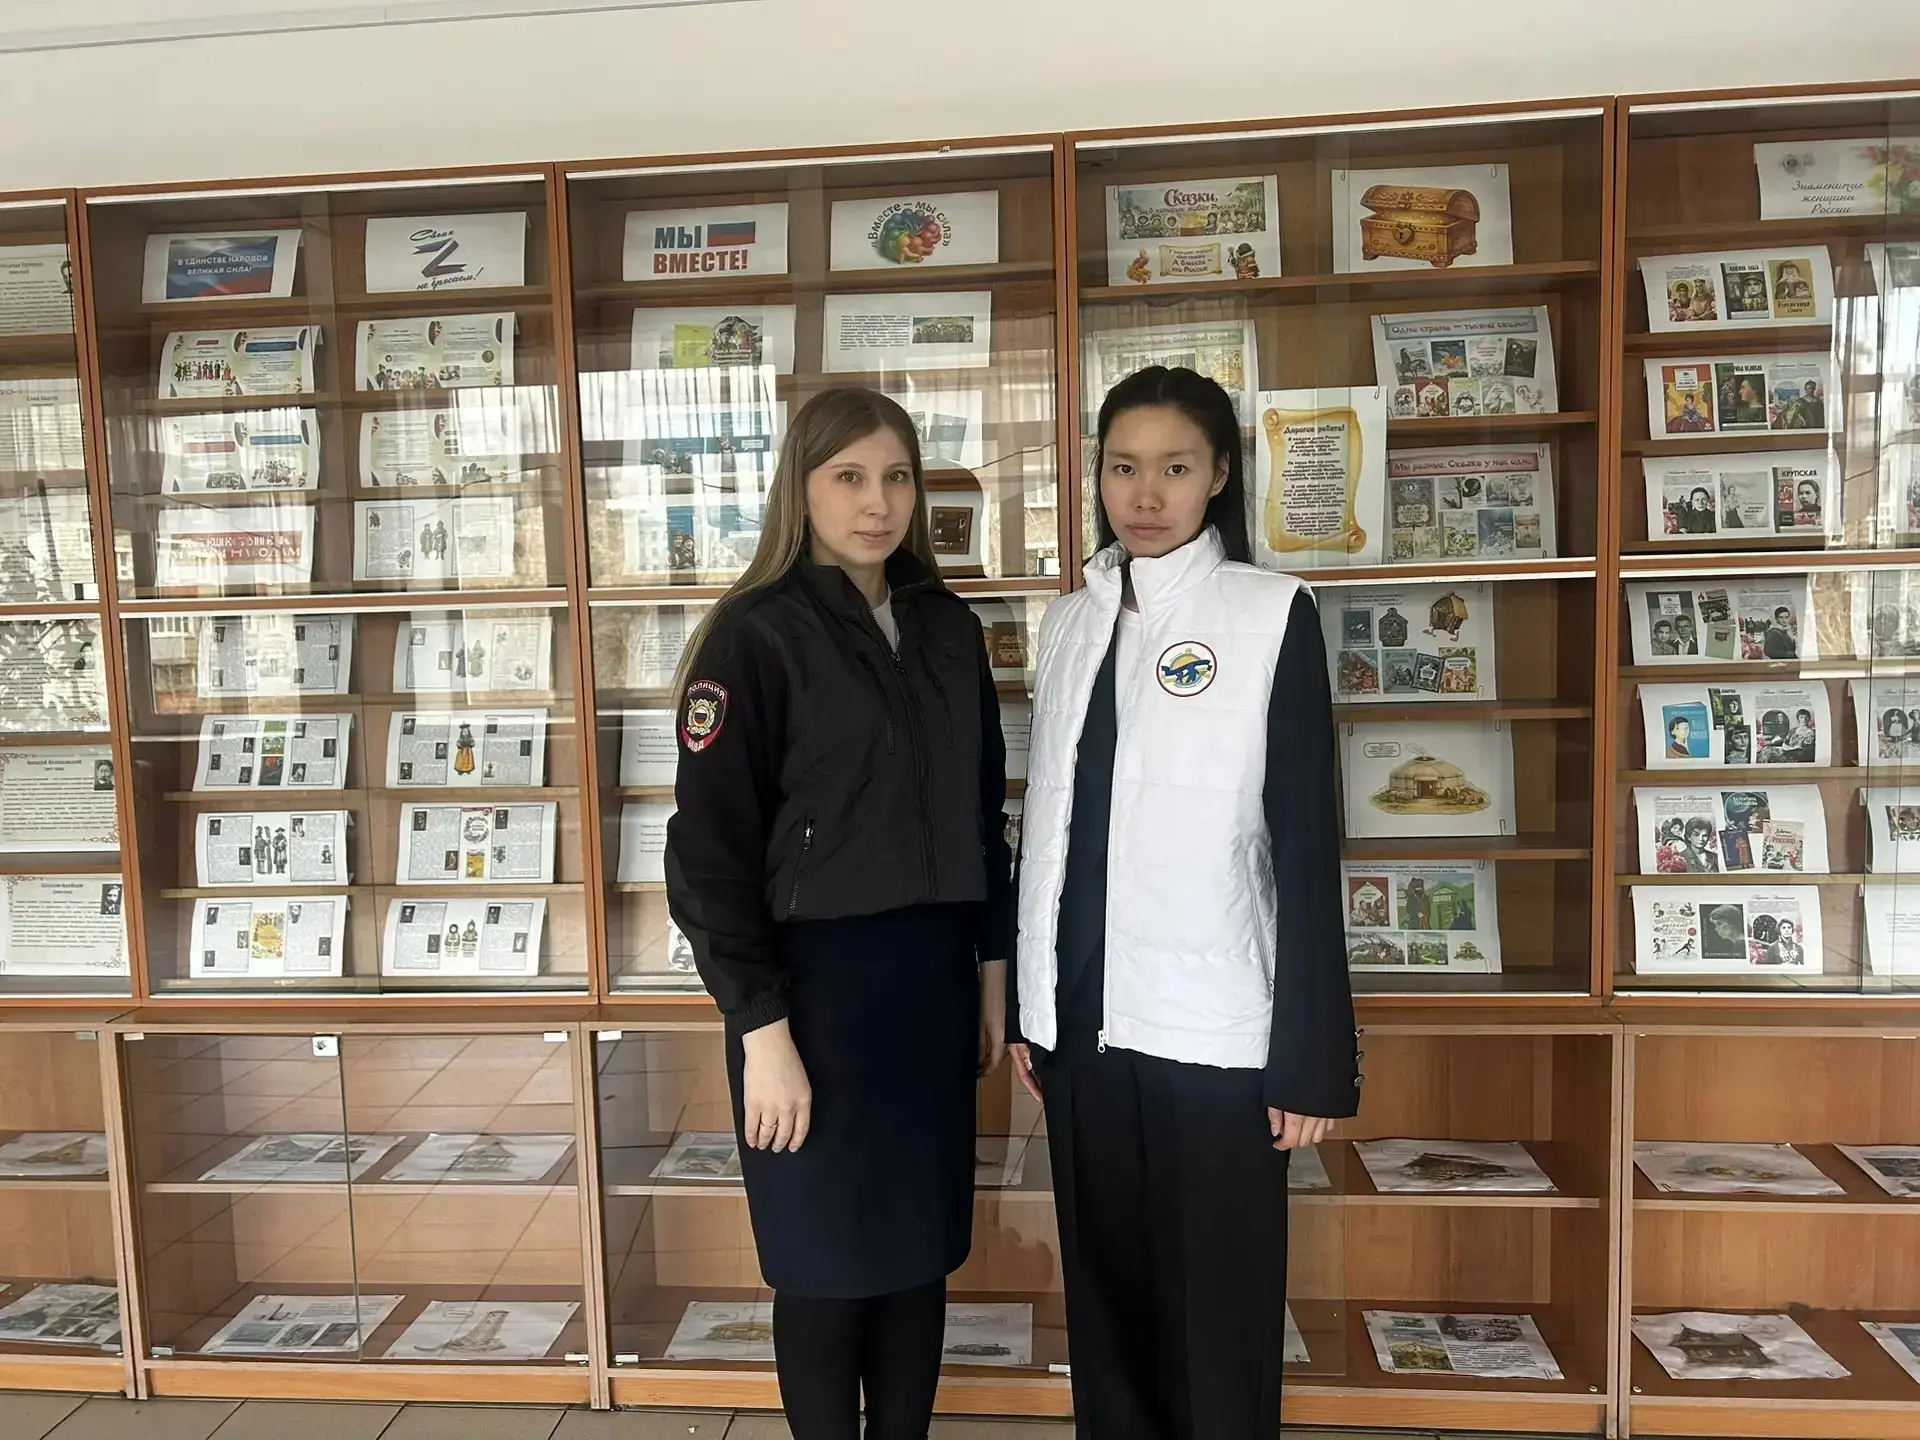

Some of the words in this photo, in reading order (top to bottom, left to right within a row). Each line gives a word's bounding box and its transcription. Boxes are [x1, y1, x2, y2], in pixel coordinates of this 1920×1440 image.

[1791, 180, 1865, 191] Знаменитые
[1801, 194, 1857, 204] женщины
[1811, 203, 1851, 214] России
[868, 202, 903, 248] «Вместе
[914, 201, 937, 214] мы
[936, 212, 952, 247] сила»
[409, 229, 454, 241] Своих
[654, 225, 702, 249] МЫ
[185, 256, 227, 266] ЕДИНСТВЕ
[228, 254, 268, 263] НАРОДОВ
[653, 249, 748, 274] ВМЕСТЕ!
[187, 266, 224, 275] ВЕЛИКАЯ
[1283, 426, 1315, 435] Дорогие
[1316, 424, 1345, 433] ребята!
[1448, 460, 1482, 468] Сказка
[1510, 458, 1532, 466] одна
[1781, 469, 1818, 477] КРУПСКАЯ
[687, 682, 726, 700] ПОЛИЦИЯ
[687, 737, 705, 753] МВД
